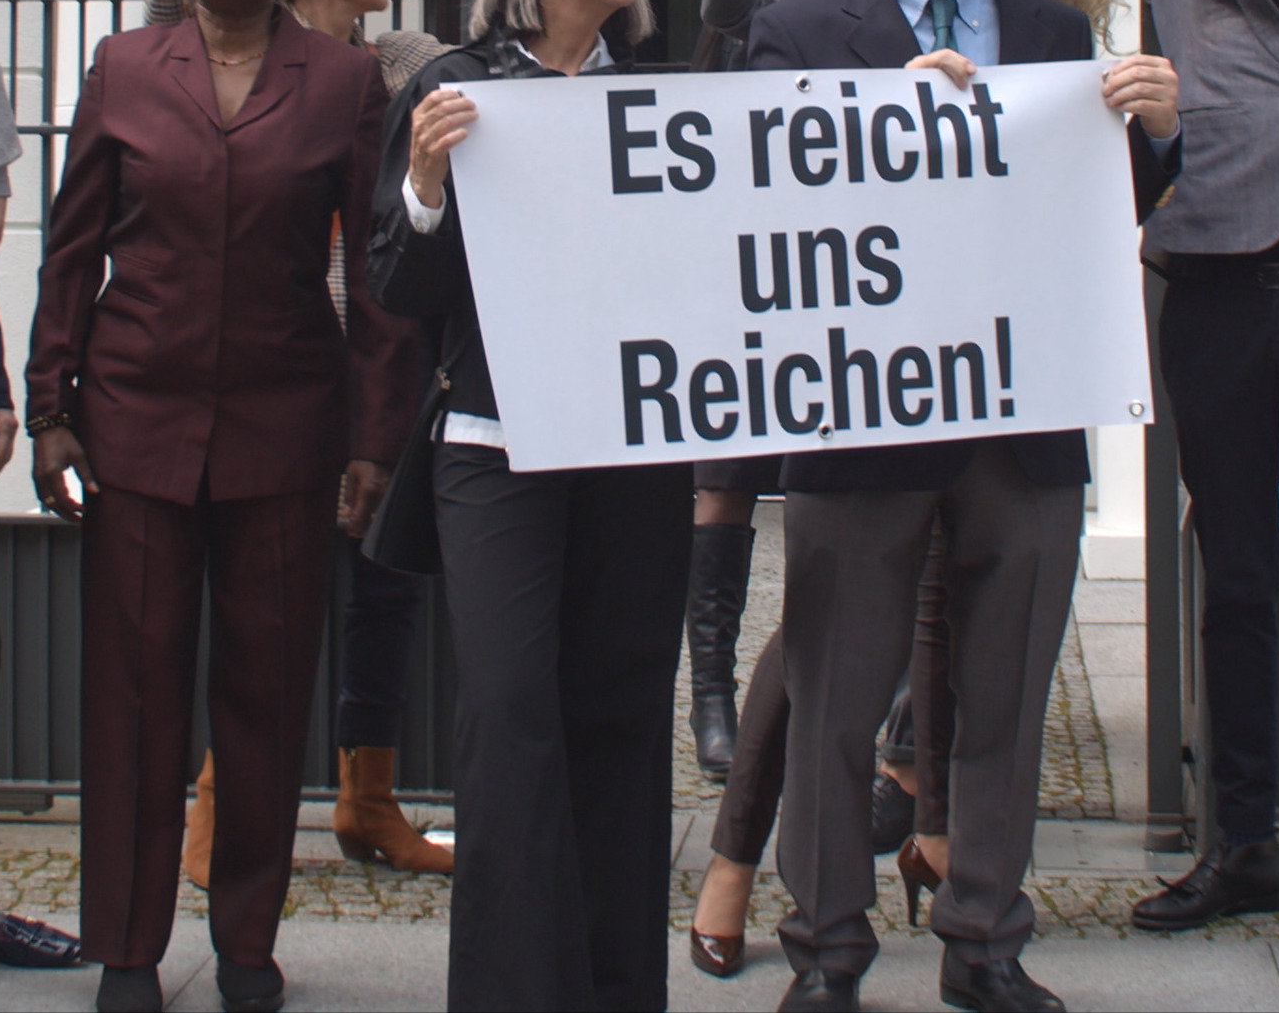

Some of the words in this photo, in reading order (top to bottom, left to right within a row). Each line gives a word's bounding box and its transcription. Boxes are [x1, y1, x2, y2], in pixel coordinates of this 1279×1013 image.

[606, 88, 717, 195] Es
[749, 80, 1009, 189] reicht
[737, 224, 903, 314] uns
[619, 316, 1016, 447] Reichen!
